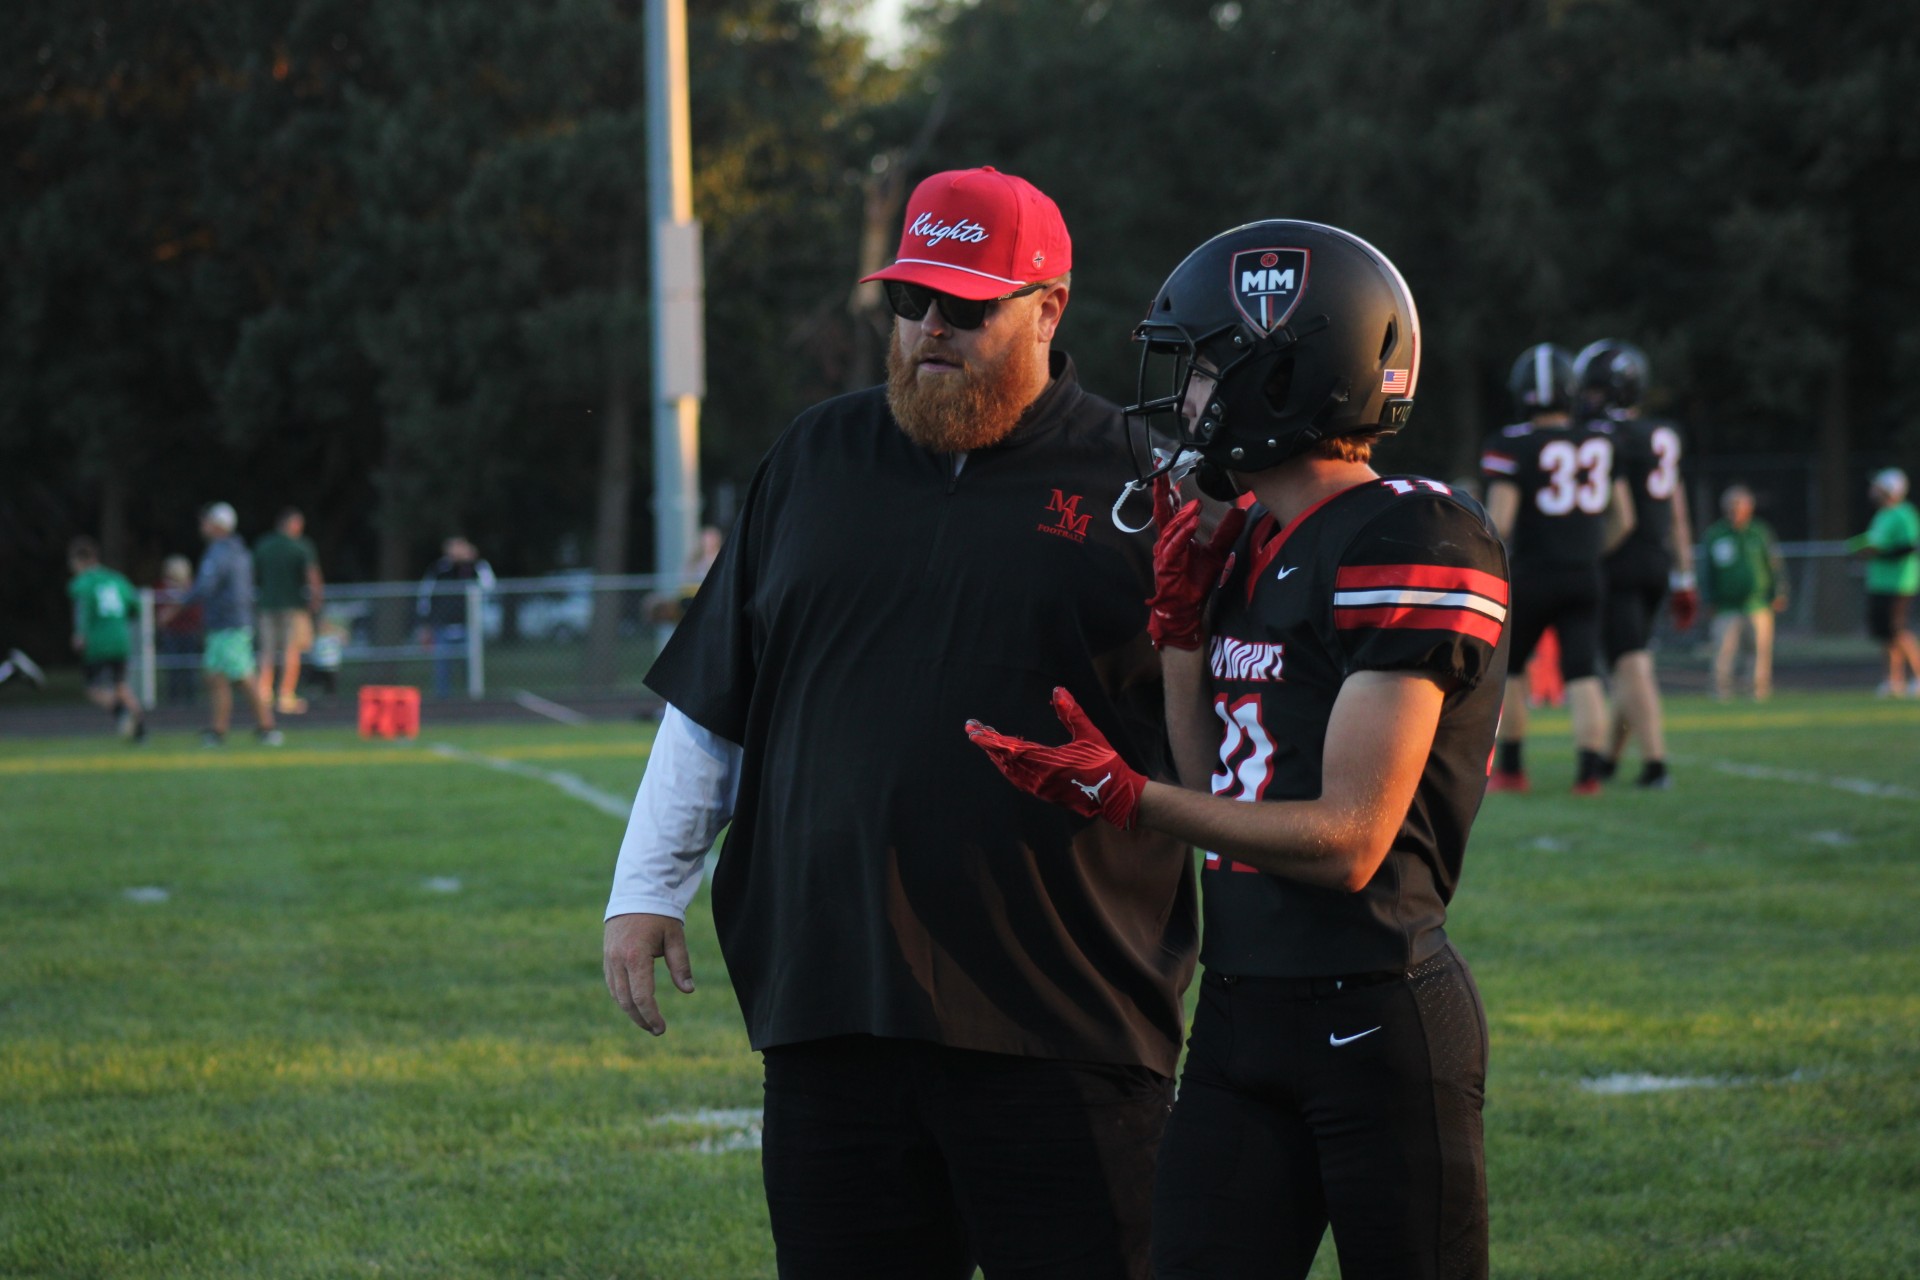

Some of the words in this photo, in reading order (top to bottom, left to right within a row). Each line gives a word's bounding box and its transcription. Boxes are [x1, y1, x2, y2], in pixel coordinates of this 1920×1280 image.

[908, 211, 990, 247] Knights
[1241, 268, 1294, 292] MM
[1535, 437, 1614, 516] 33
